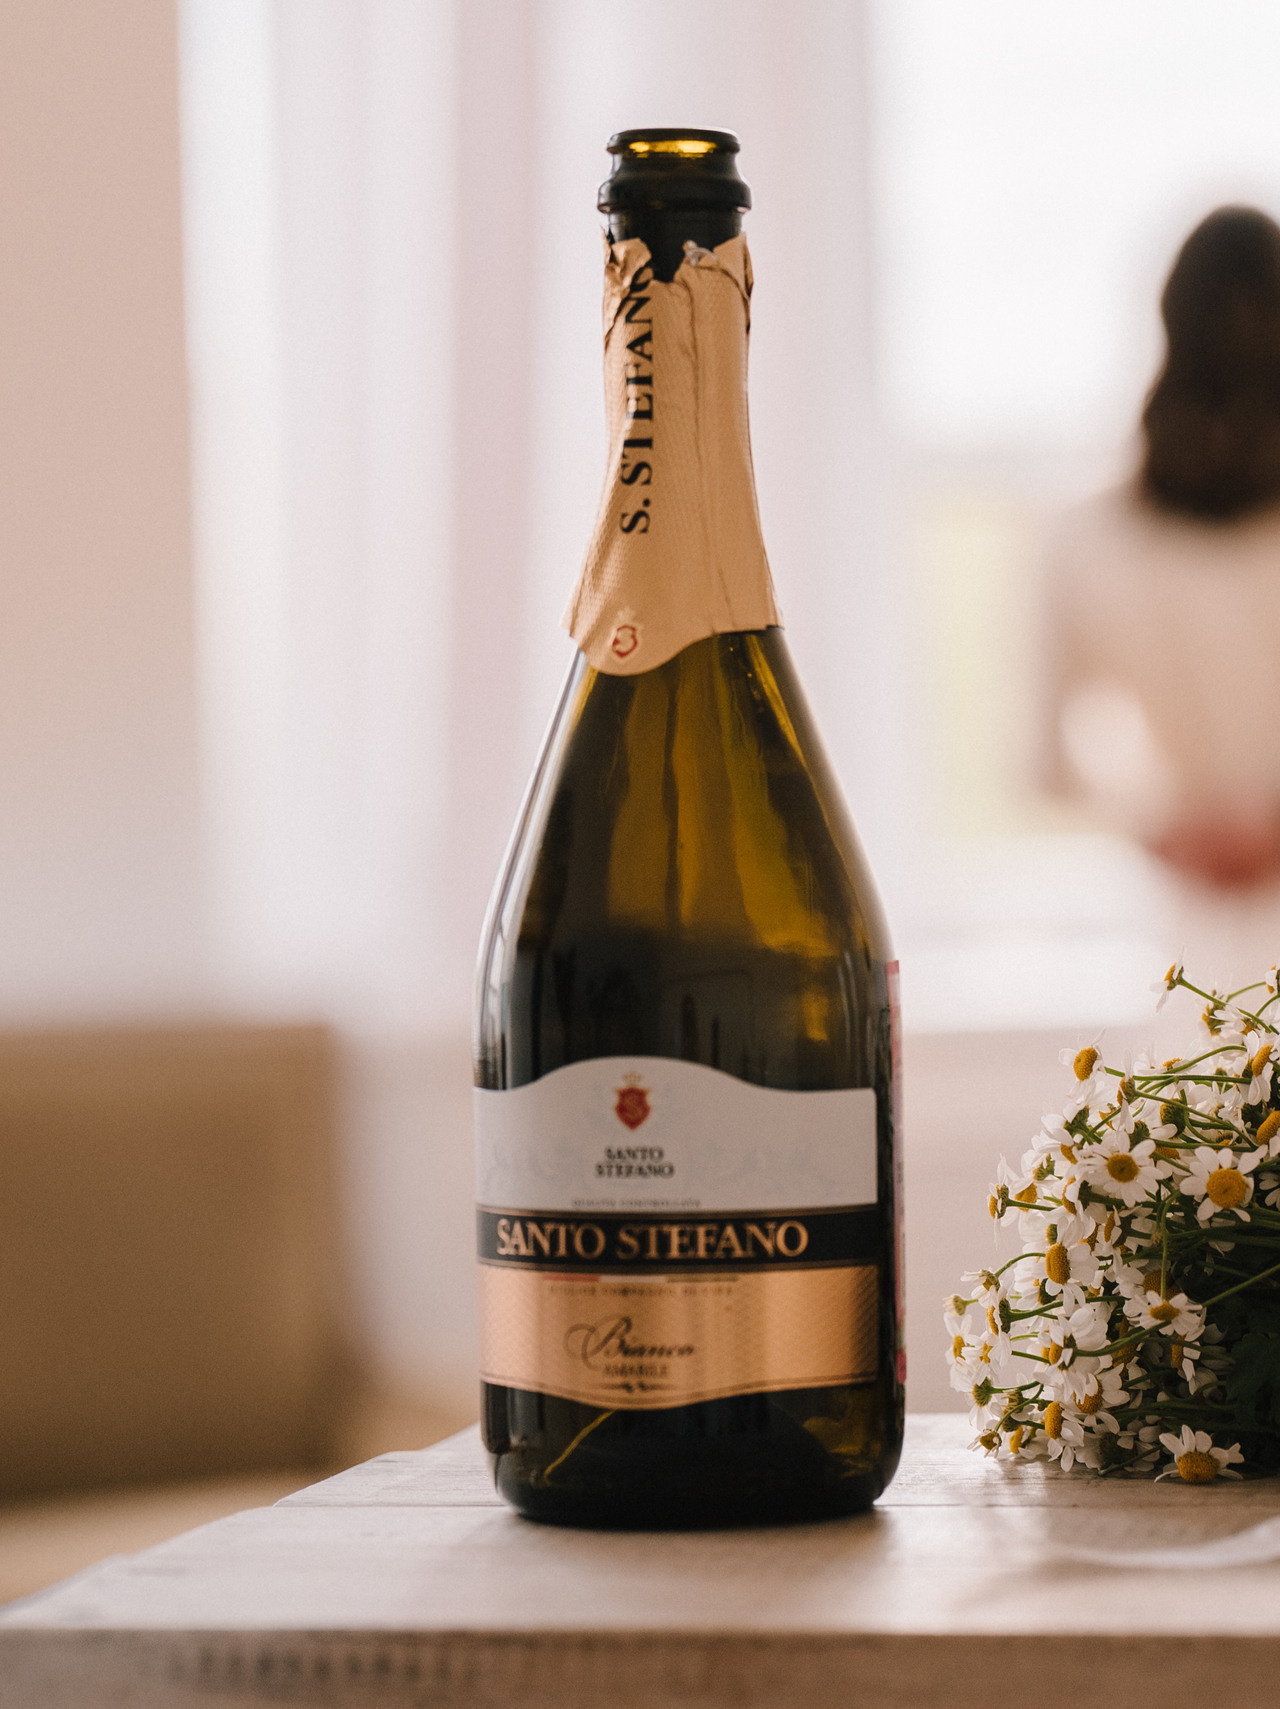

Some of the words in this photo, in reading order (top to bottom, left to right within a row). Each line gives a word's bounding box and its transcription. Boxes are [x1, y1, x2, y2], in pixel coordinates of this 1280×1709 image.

[619, 497, 651, 535] S.
[594, 1161, 676, 1179] STEFANO
[604, 1145, 665, 1162] SANTO
[496, 1218, 607, 1260] SANTO
[616, 1219, 809, 1260] STEFANO
[563, 1314, 696, 1370] Bianco
